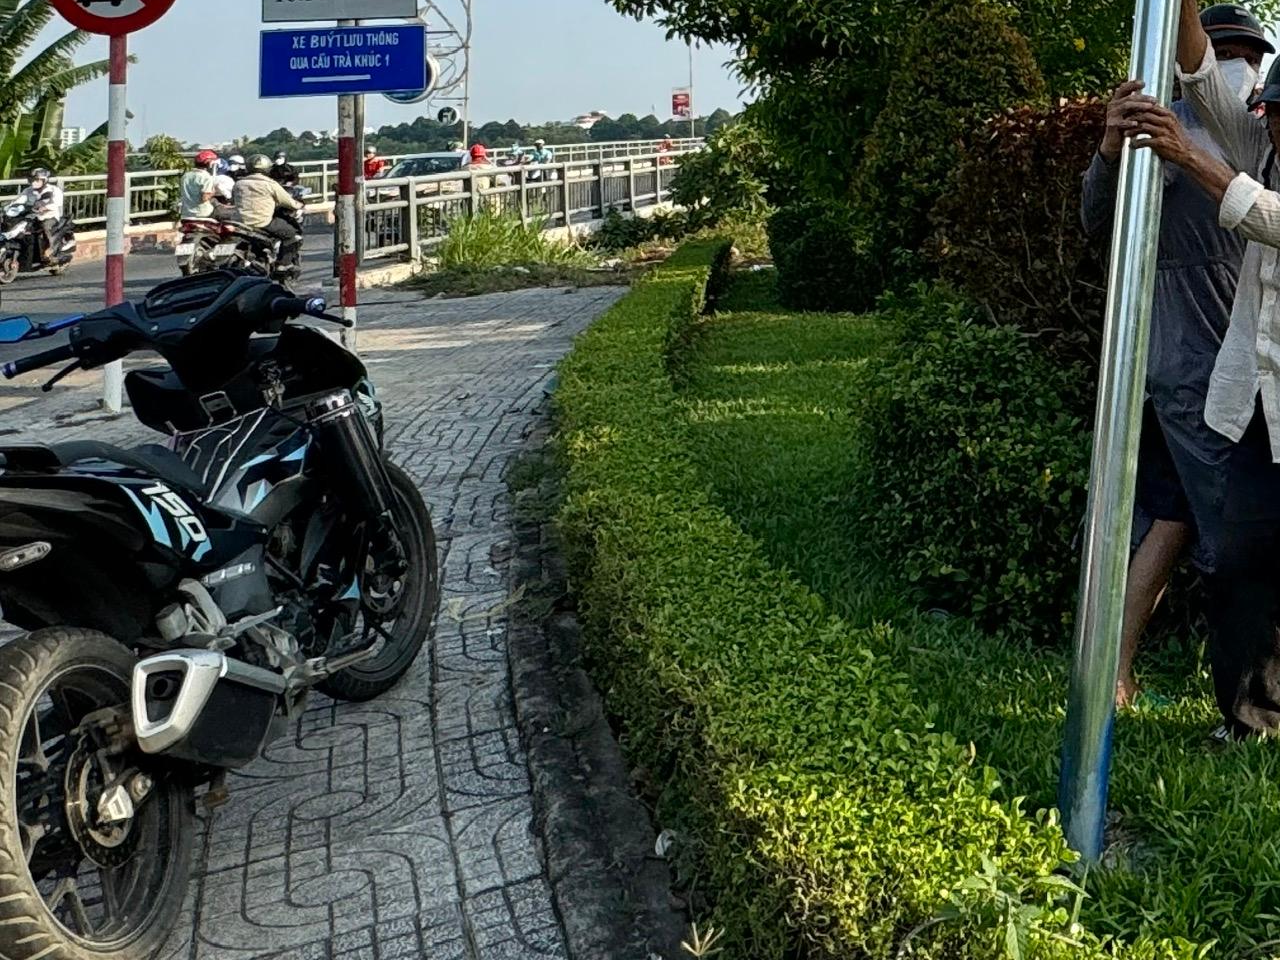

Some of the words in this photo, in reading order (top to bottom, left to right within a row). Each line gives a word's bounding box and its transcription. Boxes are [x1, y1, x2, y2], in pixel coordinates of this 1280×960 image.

[292, 36, 306, 49] XE
[290, 56, 309, 70] QUA
[141, 481, 208, 542] 150
